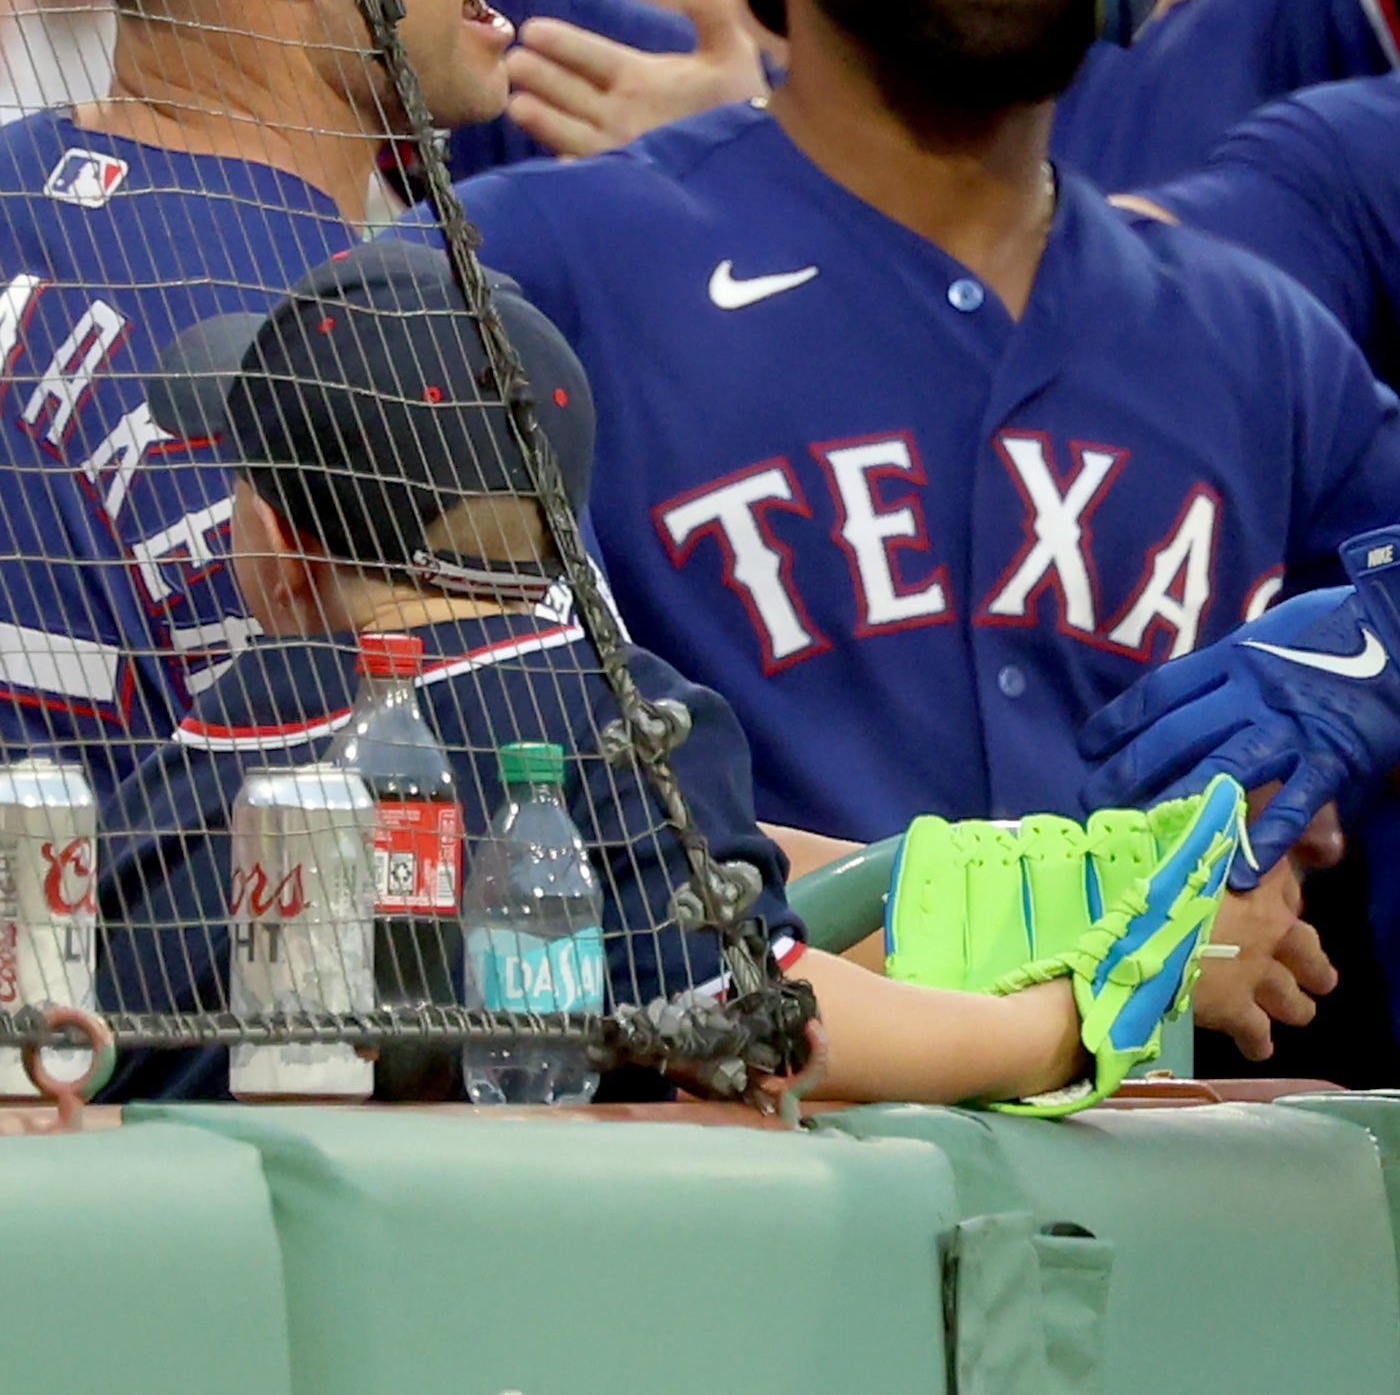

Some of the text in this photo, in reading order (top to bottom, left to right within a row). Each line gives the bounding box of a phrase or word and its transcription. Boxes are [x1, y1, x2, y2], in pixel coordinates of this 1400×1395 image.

[0, 272, 266, 711] AKER
[651, 428, 1286, 677] TEXA
[505, 941, 603, 1010] DASA
